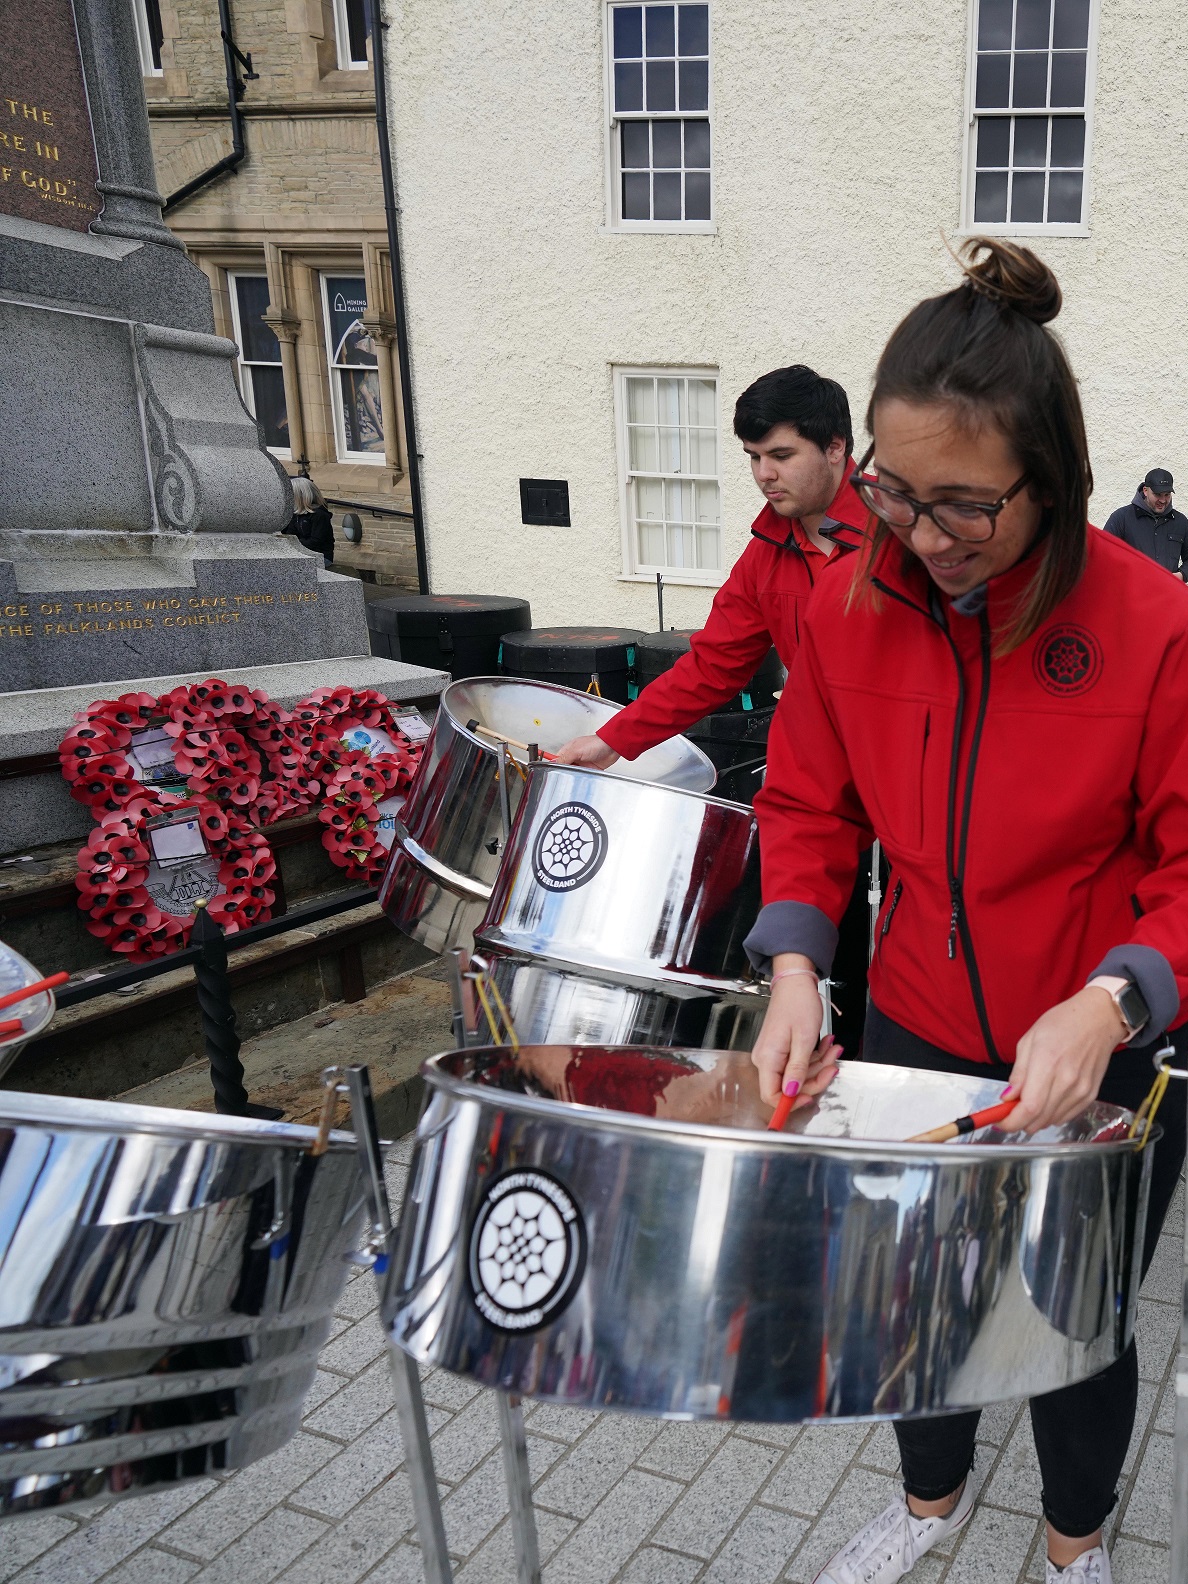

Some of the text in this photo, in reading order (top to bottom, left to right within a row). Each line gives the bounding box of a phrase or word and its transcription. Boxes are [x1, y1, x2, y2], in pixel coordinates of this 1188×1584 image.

[6, 99, 54, 126] THE
[36, 141, 59, 160] IN
[41, 603, 62, 615] OF
[74, 601, 134, 613] THOSE
[143, 598, 181, 611] WHO
[189, 597, 229, 609] GAVE
[234, 594, 274, 606] THEIR
[281, 592, 318, 604] LIVES
[44, 618, 154, 635] FALKLANDS
[550, 806, 602, 834] NORTH TYNESIDE
[537, 869, 577, 889] STEELBAND
[488, 1173, 578, 1224] NORTH TYNESIDE
[475, 1290, 545, 1330] STEELBAND
